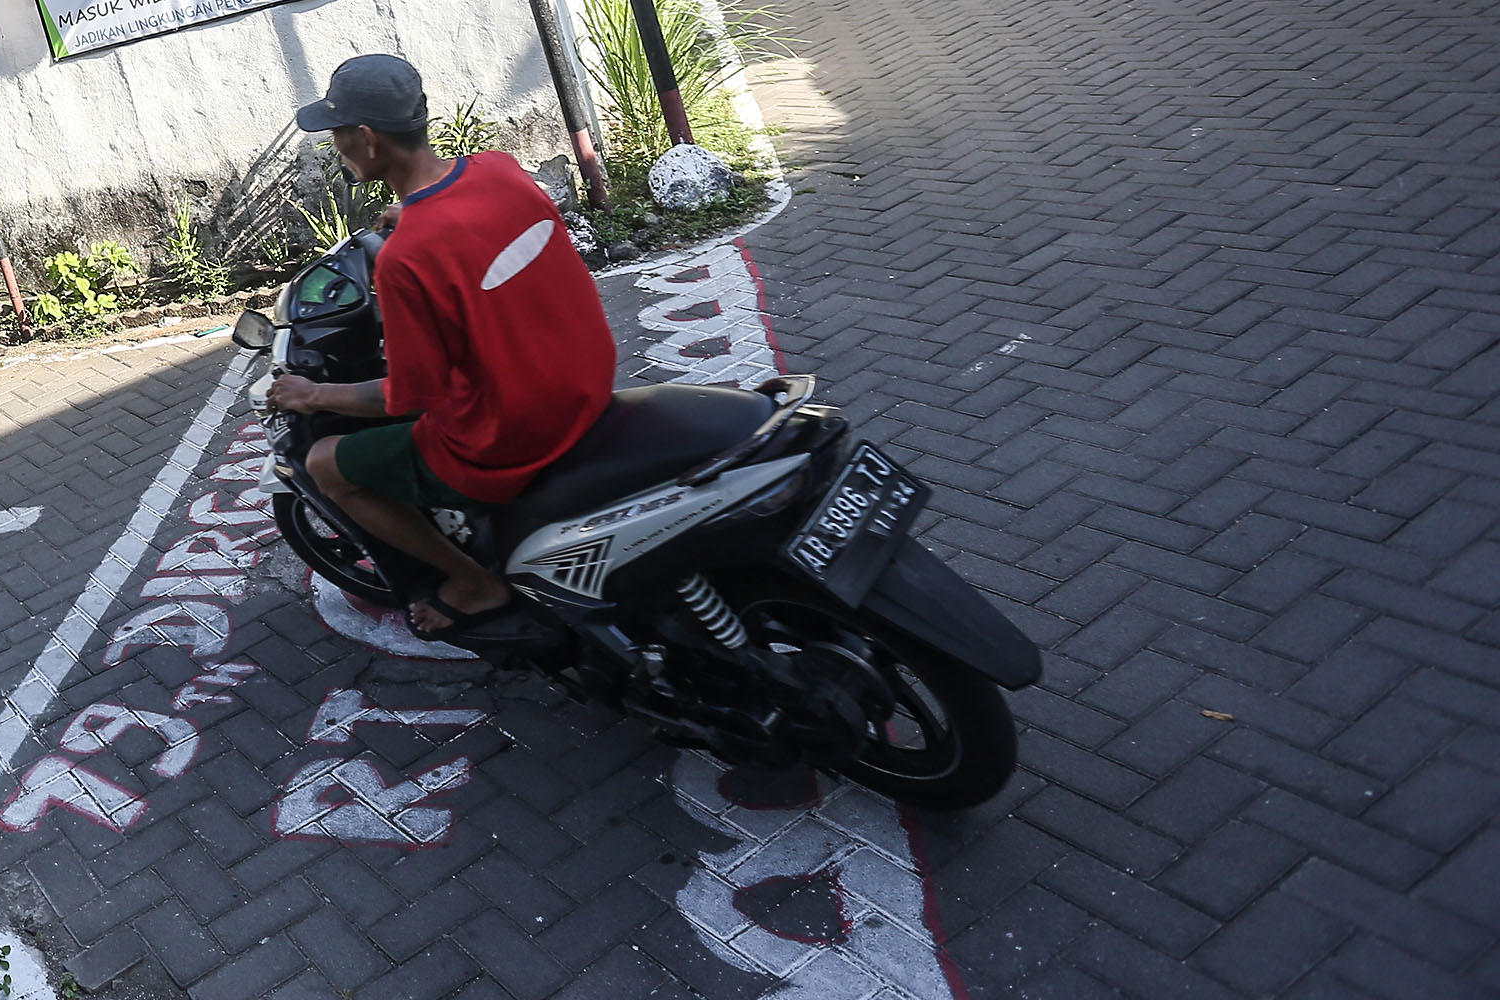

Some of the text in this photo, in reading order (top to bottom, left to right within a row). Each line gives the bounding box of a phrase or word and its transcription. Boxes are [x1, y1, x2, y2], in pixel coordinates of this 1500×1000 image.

[58, 0, 124, 29] MASUK
[74, 24, 126, 49] JADIKAN
[127, 1, 213, 33] LINGKUNGAN
[798, 452, 891, 567] AB 5996 TJ
